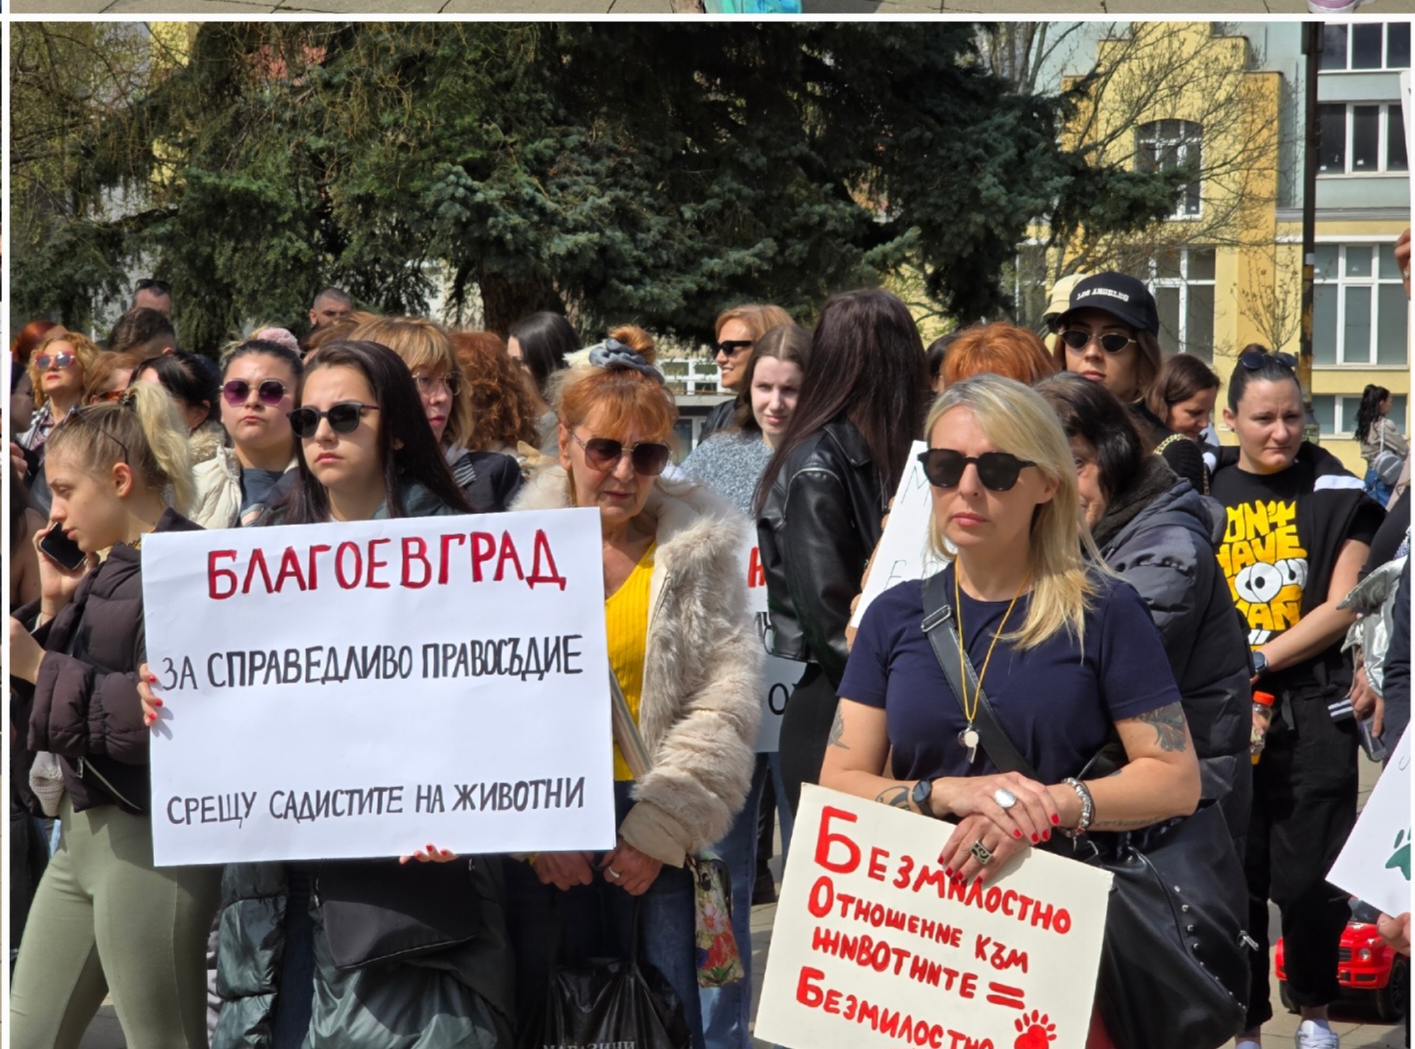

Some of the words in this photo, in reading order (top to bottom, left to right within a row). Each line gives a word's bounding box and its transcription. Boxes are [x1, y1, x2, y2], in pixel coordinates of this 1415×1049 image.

[1076, 289, 1091, 301] LOS
[1092, 288, 1129, 302] ANGELES
[207, 529, 566, 600] БЛАГОЕВГРАД
[163, 656, 198, 691] ЗА
[207, 645, 412, 687] СПРАВЕДЛИВО
[423, 634, 584, 681] ПРАВОСЪДИЕ
[167, 791, 257, 828] СРЕЩУ
[269, 785, 403, 821] САДИСТИТЕ
[416, 784, 445, 814] НА
[452, 777, 585, 813] ЖИВОТНИ
[814, 805, 1071, 934] БЕЗМИЛОСТНО
[808, 876, 963, 948] ОТНОШЕНИЕ
[976, 934, 1029, 974] КЪМ
[813, 926, 979, 999] ЖИВОТНИТЕ
